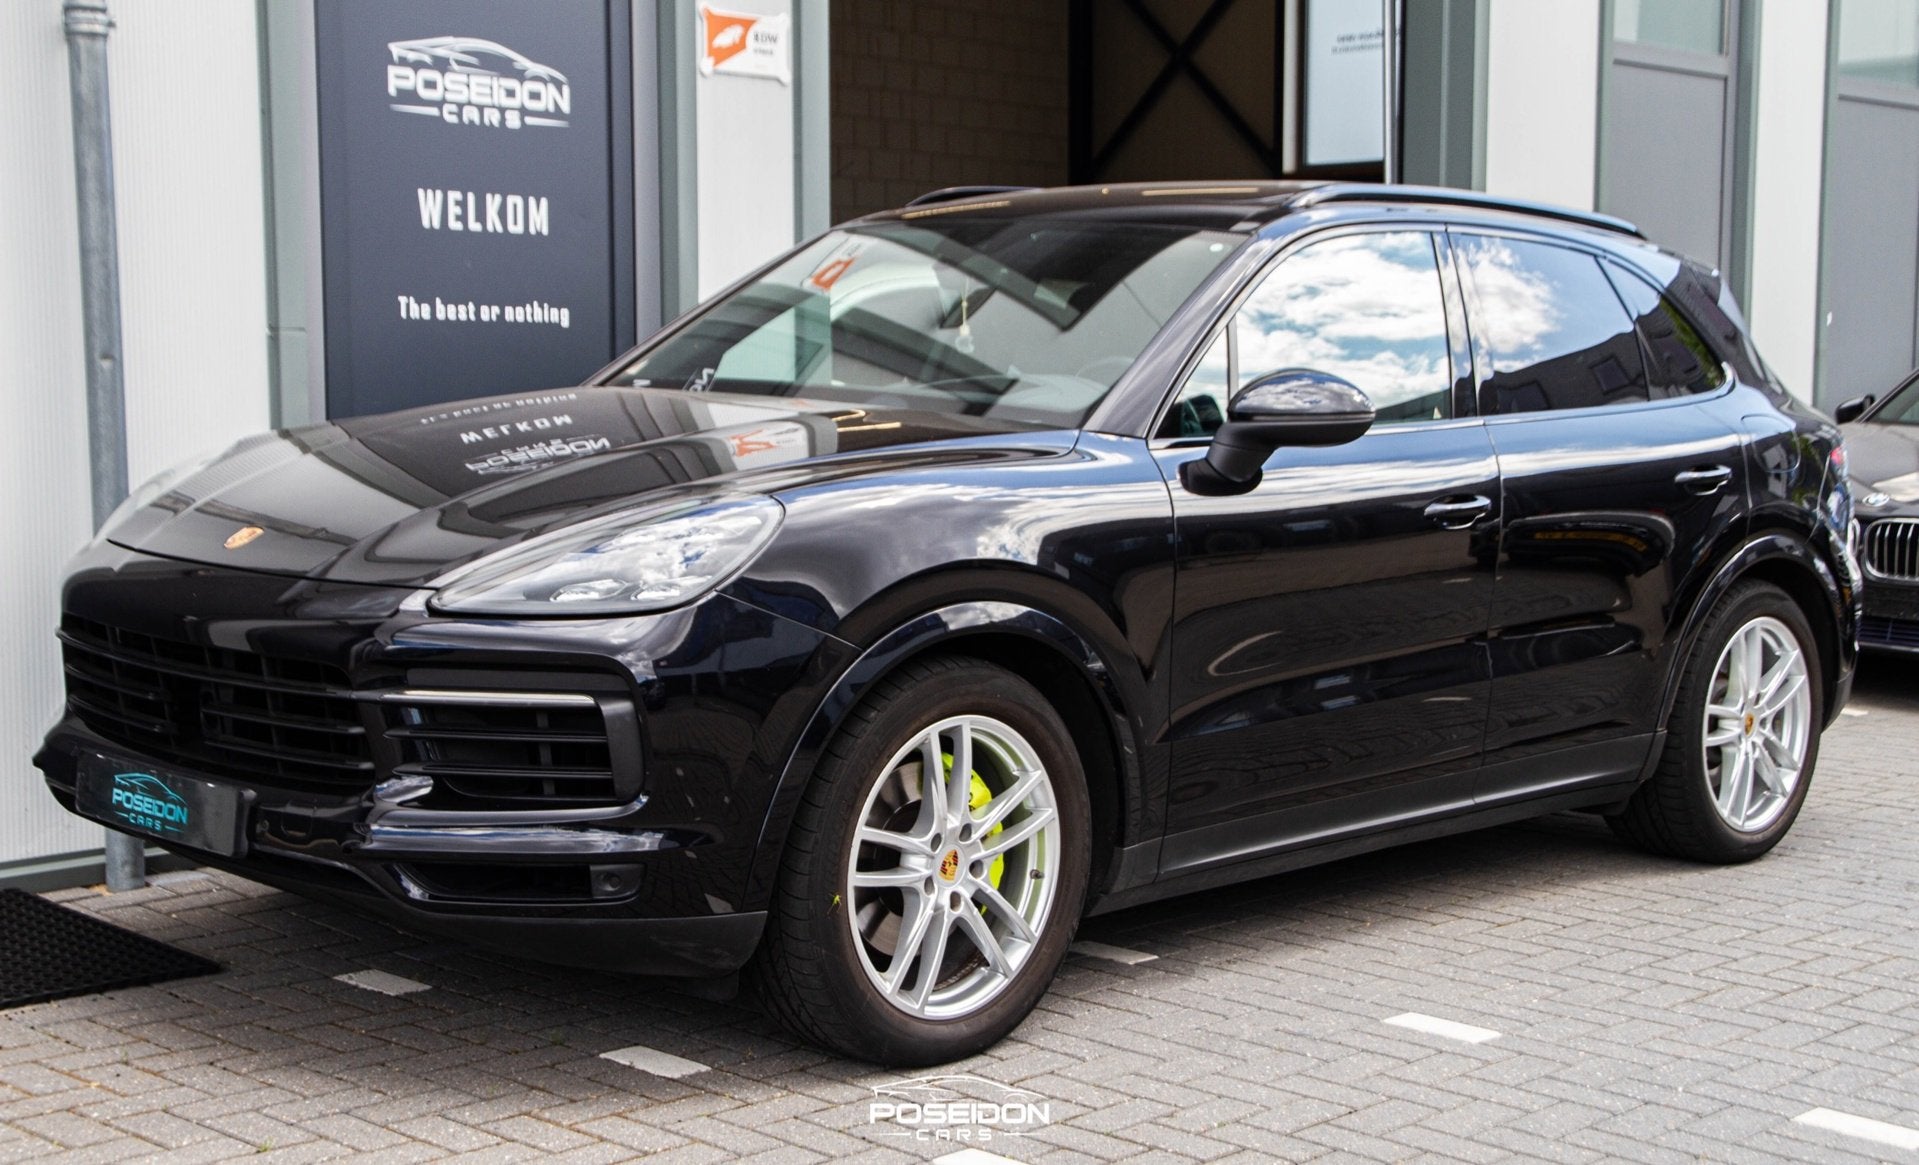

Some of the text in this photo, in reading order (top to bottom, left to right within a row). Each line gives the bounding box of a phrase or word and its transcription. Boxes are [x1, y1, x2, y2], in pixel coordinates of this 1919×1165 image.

[387, 64, 571, 115] POSEIDON
[442, 103, 522, 130] CARS
[417, 187, 549, 236] WELKOM
[398, 295, 570, 328] The best or nothing
[112, 788, 188, 825] POSEIDON
[128, 813, 162, 831] CARS
